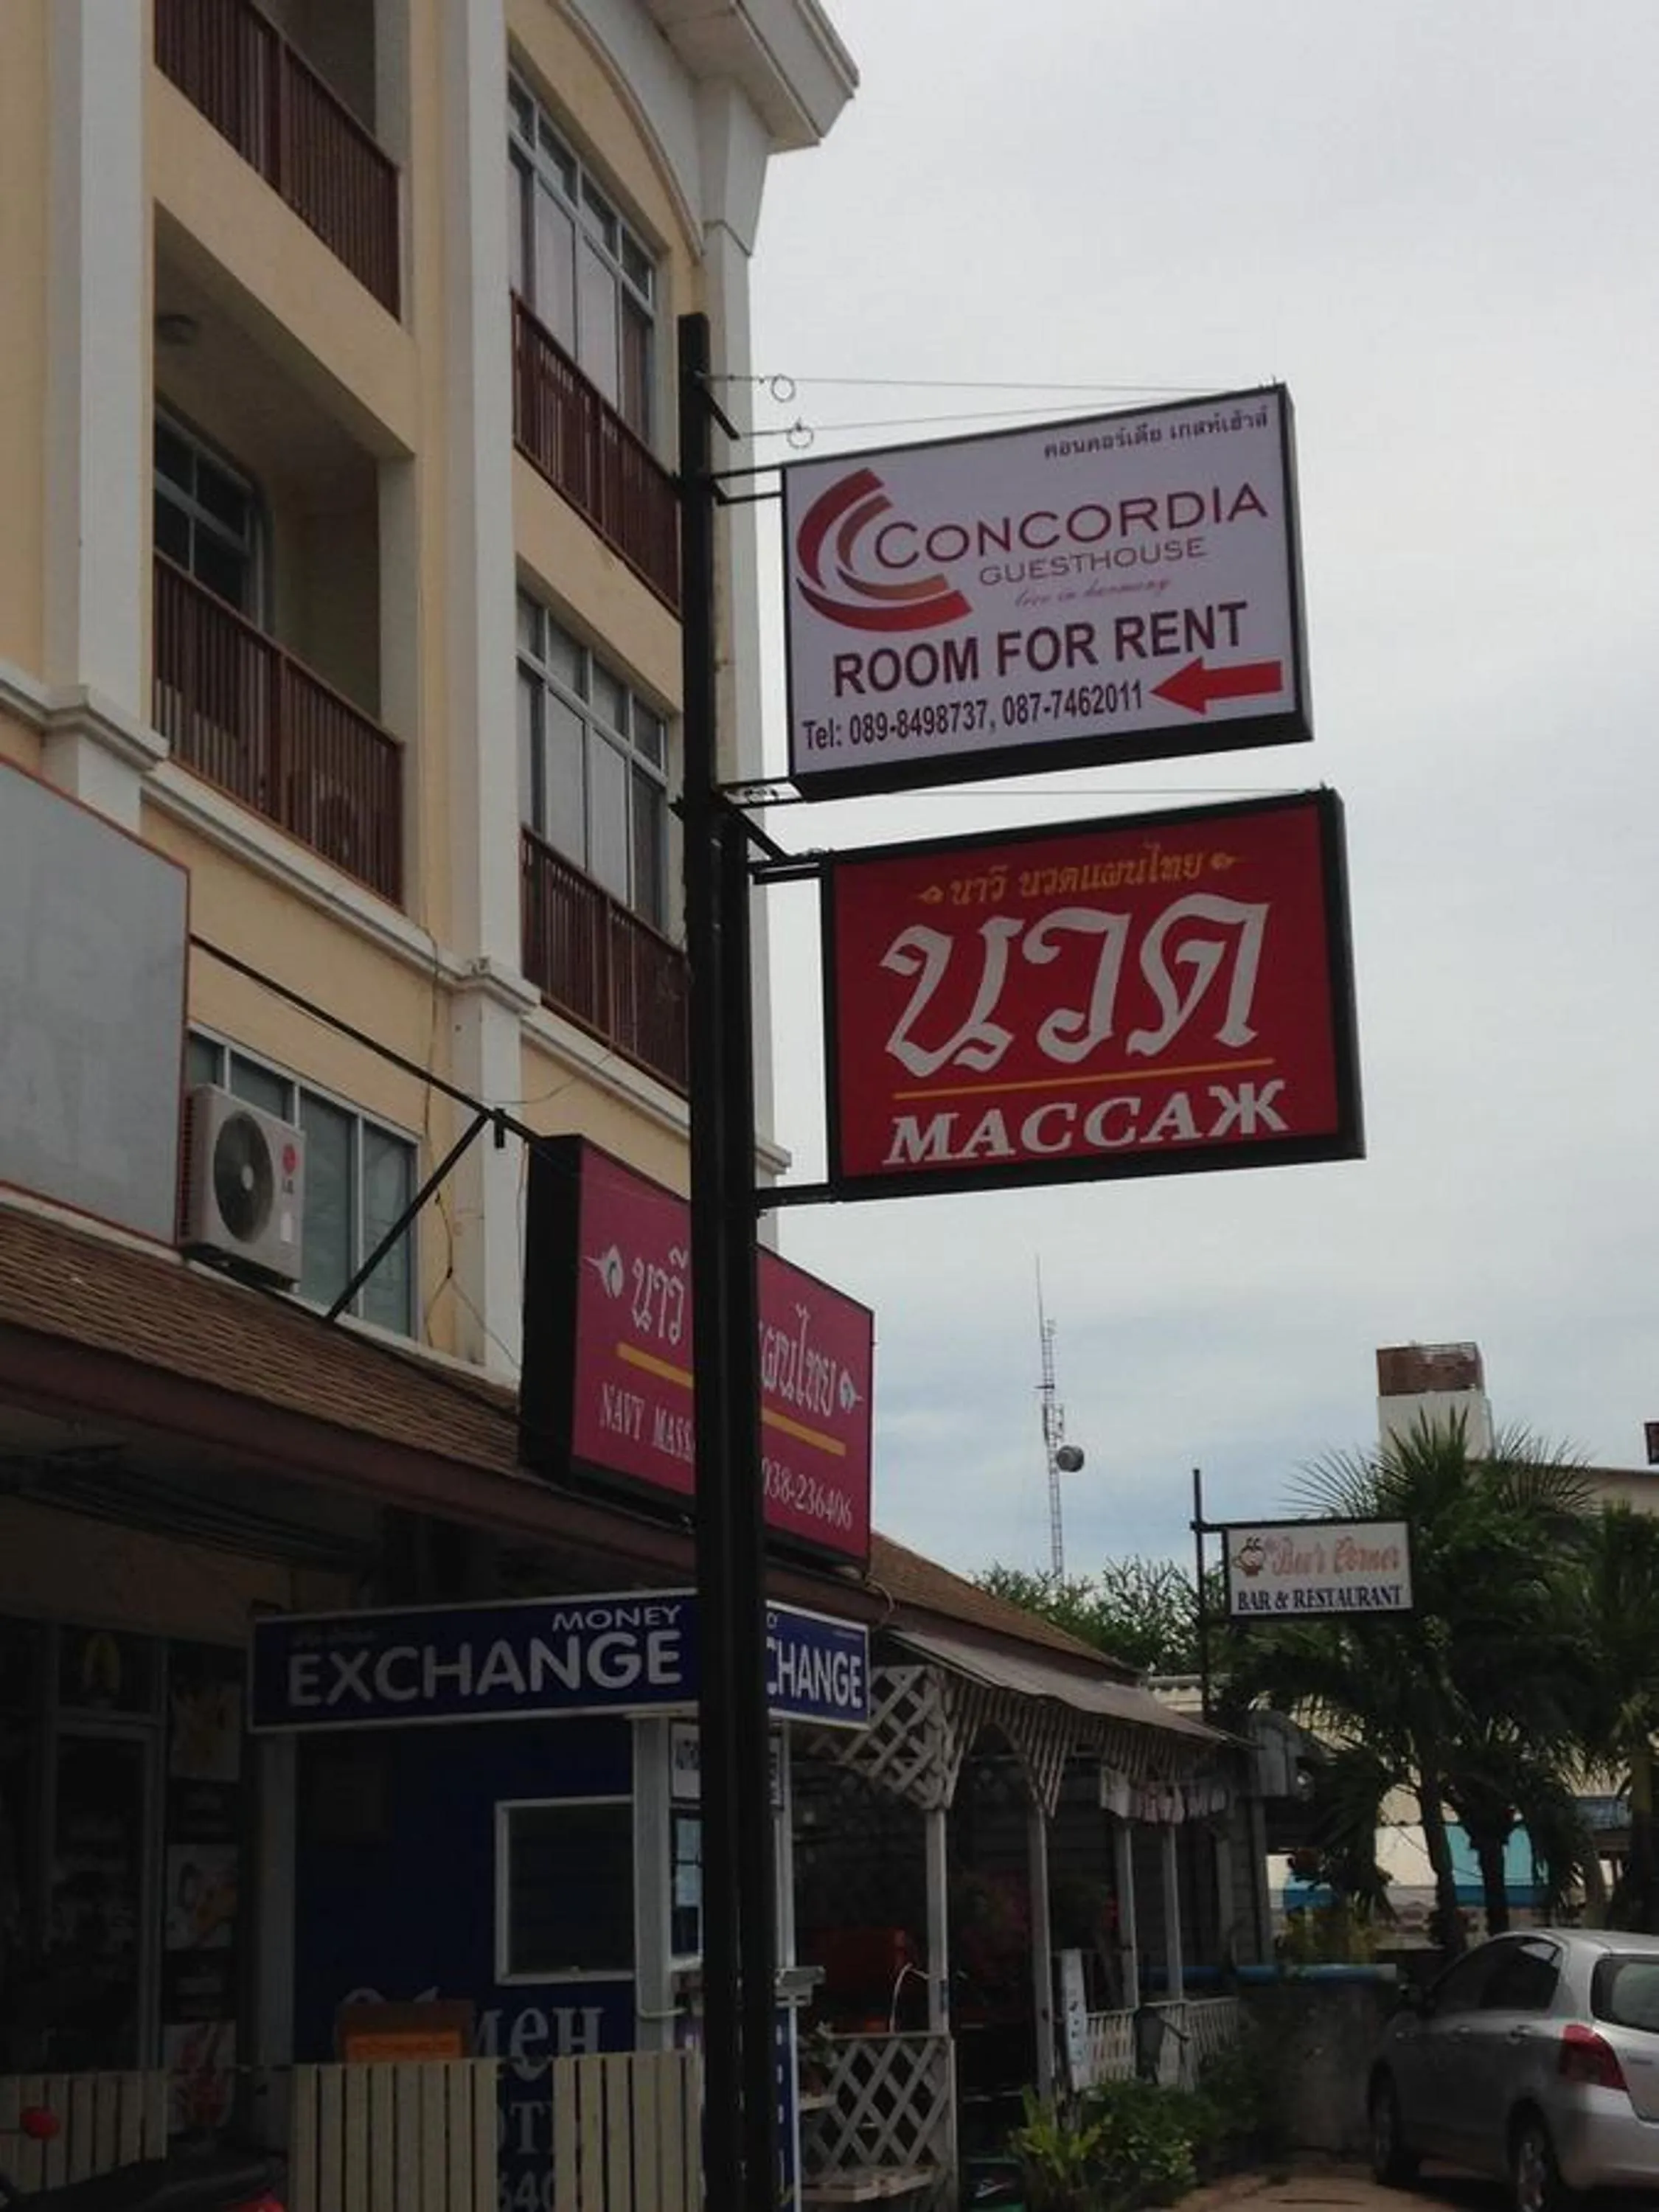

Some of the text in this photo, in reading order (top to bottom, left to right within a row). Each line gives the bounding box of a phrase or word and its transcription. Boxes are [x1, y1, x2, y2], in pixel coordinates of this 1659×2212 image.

[875, 482, 1268, 569] CONCORDIA
[978, 538, 1207, 587] GUESTHOUSE
[832, 602, 1248, 698] ROOM FOR RENT
[802, 719, 844, 751] Tel:
[1003, 679, 1144, 726] 087-7462011
[881, 893, 1270, 1078] นวด
[883, 1080, 1289, 1165] МАССАЖ
[652, 1405, 695, 1464] MASS
[551, 1604, 683, 1632] MONEY
[1238, 1585, 1402, 1611] BAR & RESTAURANT
[288, 1629, 684, 1708] EXCHANGE
